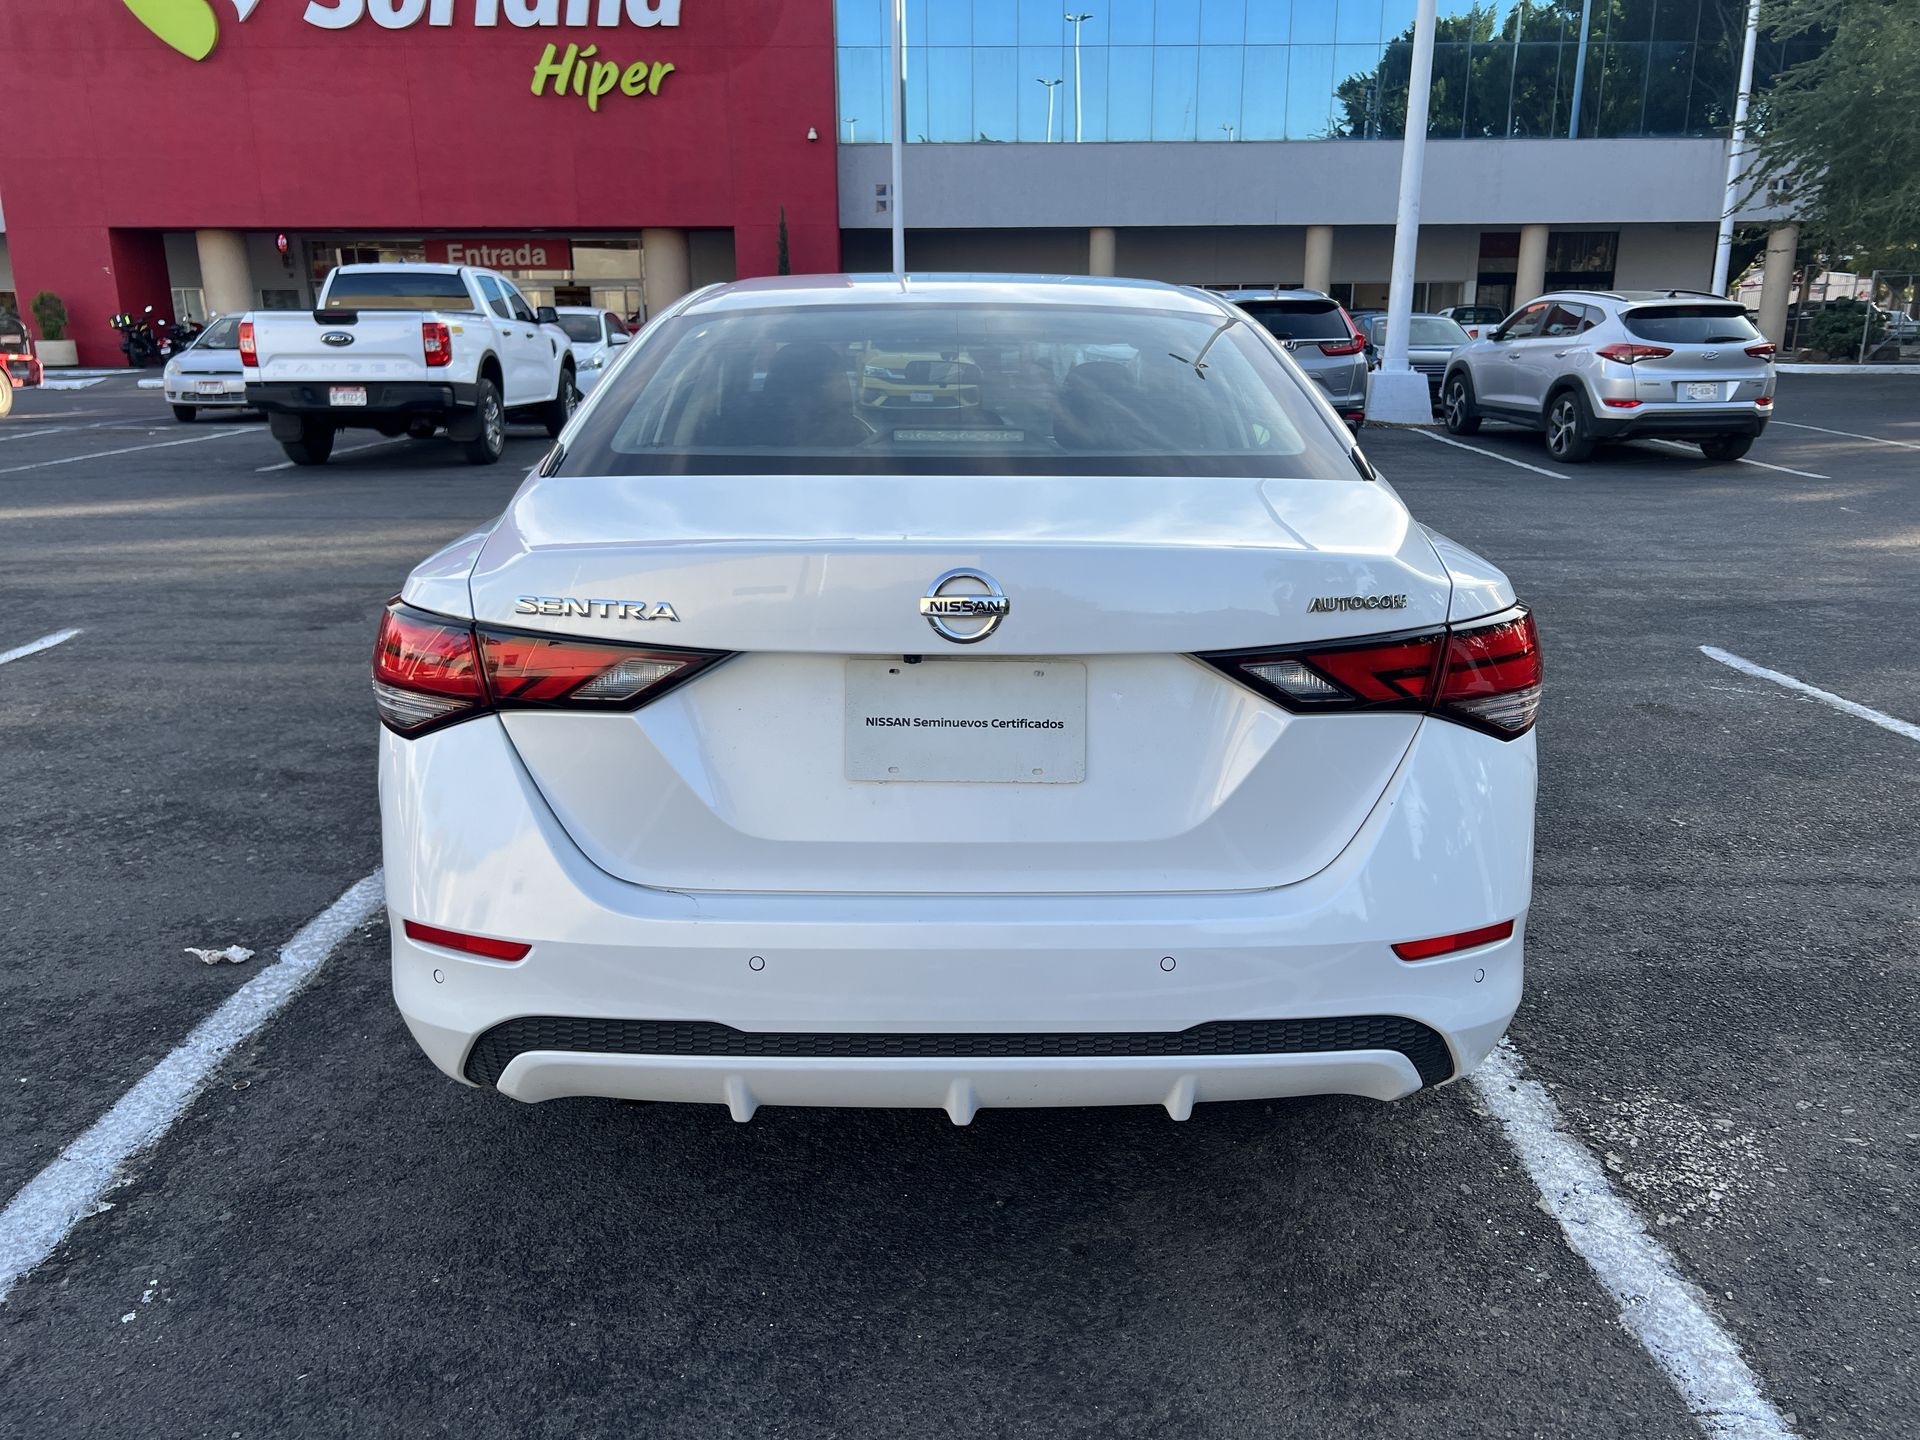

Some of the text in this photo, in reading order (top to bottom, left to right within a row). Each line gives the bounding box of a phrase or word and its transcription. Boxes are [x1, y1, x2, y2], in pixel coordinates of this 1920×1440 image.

[530, 42, 675, 112] Híper
[446, 243, 547, 266] Entrada
[514, 595, 681, 622] SENTRA
[929, 601, 1000, 613] NISSAN
[865, 717, 1065, 729] NISSAN Seminuevos Certificados
